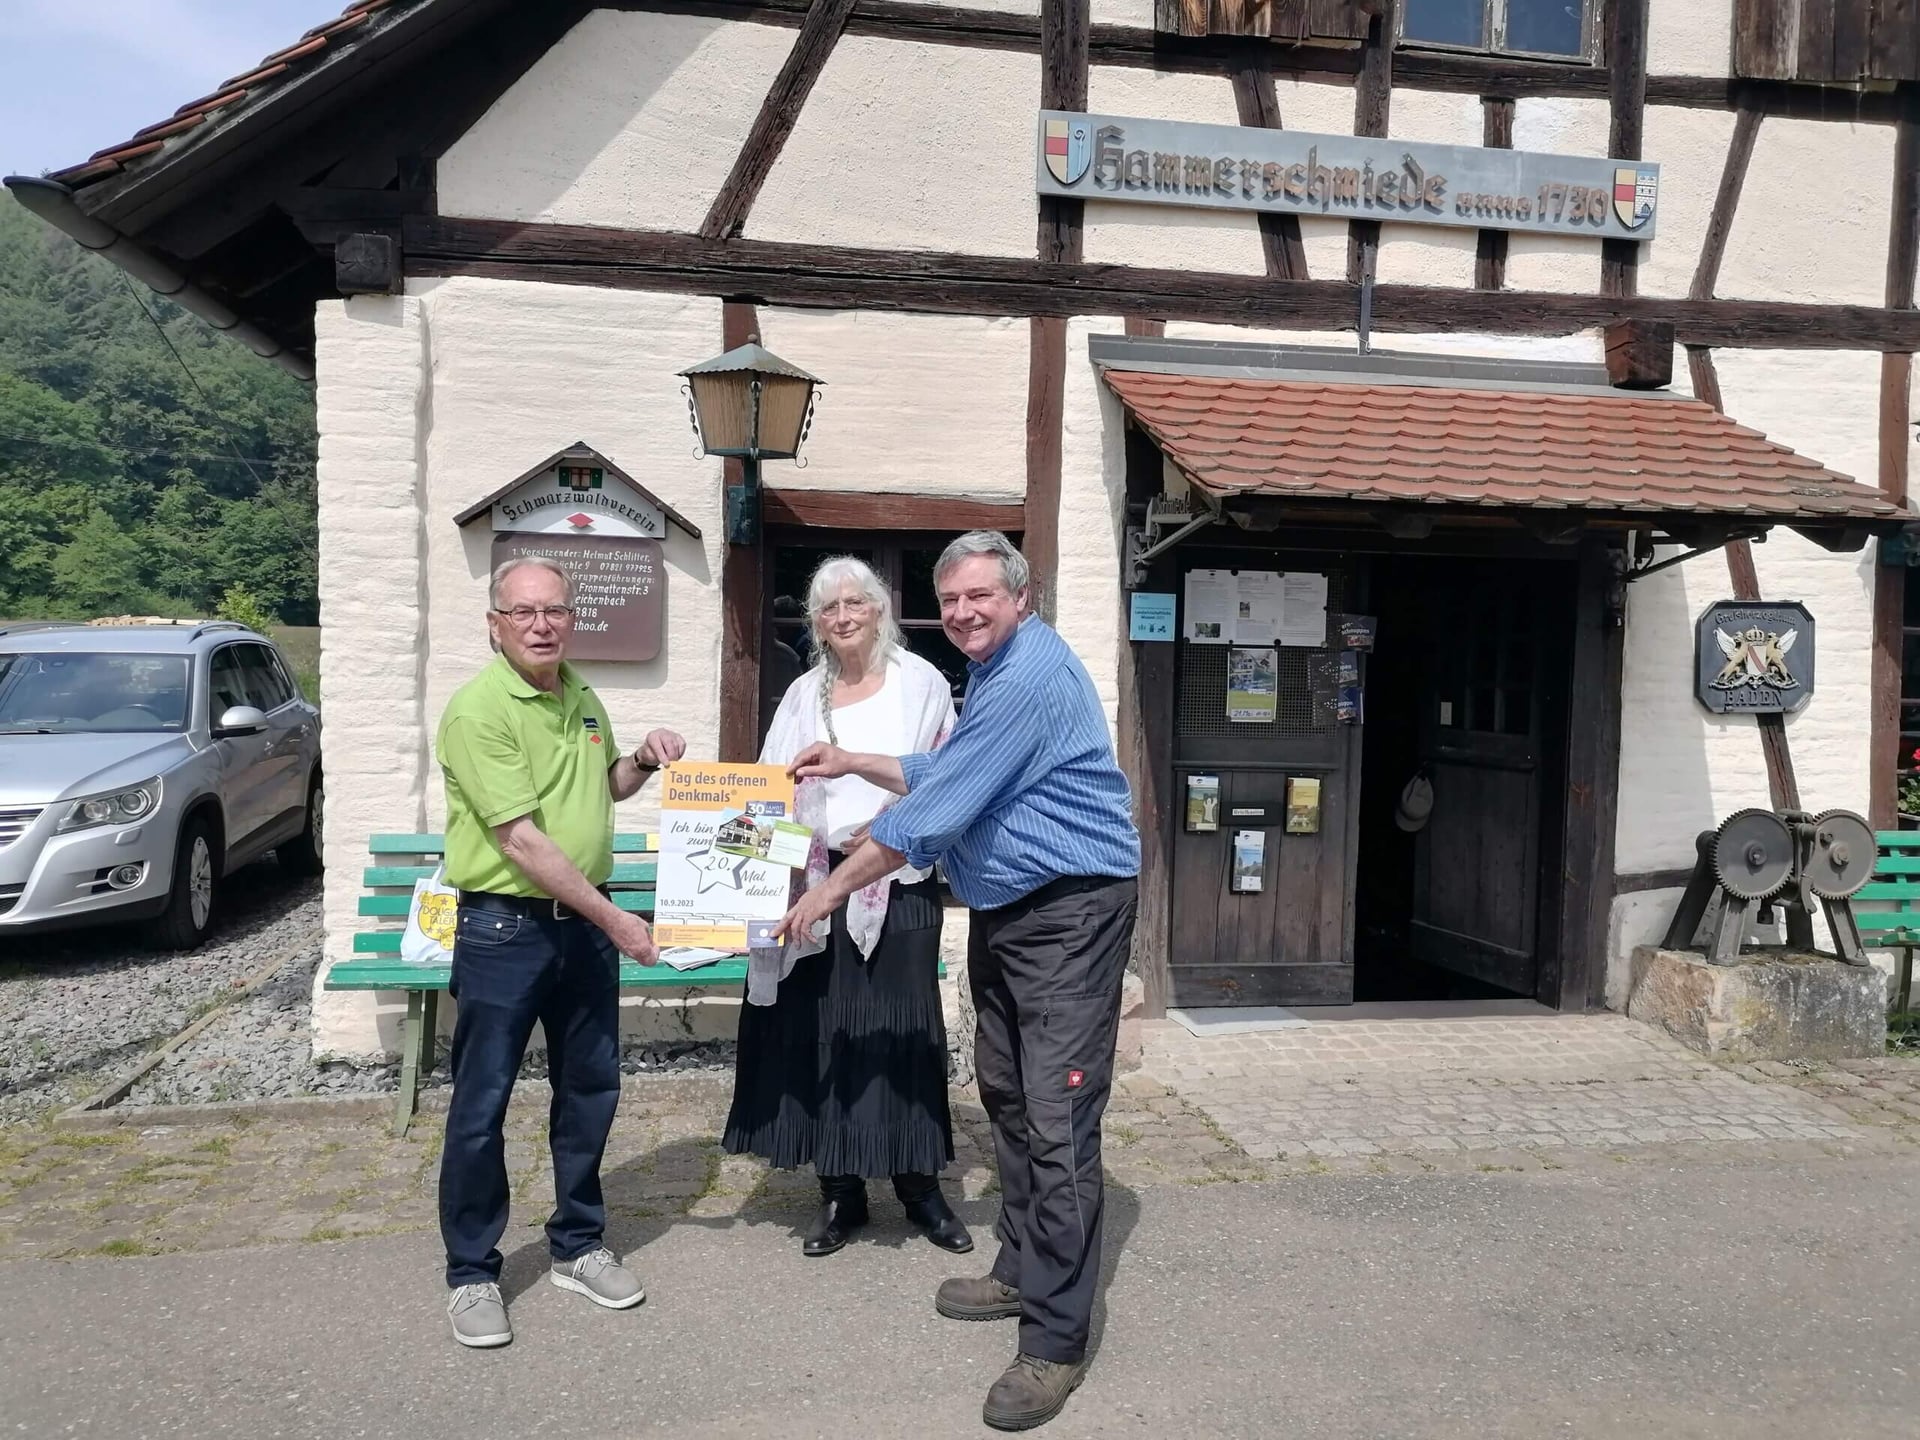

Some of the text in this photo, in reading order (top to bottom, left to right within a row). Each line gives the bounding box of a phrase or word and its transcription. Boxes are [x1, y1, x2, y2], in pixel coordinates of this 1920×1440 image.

[1095, 125, 1609, 219] Hammerschmiede anno 1730
[502, 491, 656, 532] Schwarzwaldverein
[520, 547, 582, 558] Vorsitzender:
[583, 549, 613, 560] Helmut
[600, 563, 622, 572] 07821
[571, 571, 655, 586] Gruppenführungen:
[575, 594, 626, 606] eichenbach
[1725, 691, 1782, 706] BADEN
[670, 771, 767, 787] Tag des offenen
[748, 802, 765, 815] 30
[671, 821, 713, 834] Ich bin
[687, 837, 713, 846] zum
[704, 856, 731, 871] 20.
[740, 870, 765, 882] Mal
[746, 886, 784, 897] dabei!
[660, 899, 694, 907] 10.9.2023
[430, 915, 455, 926] TALER
